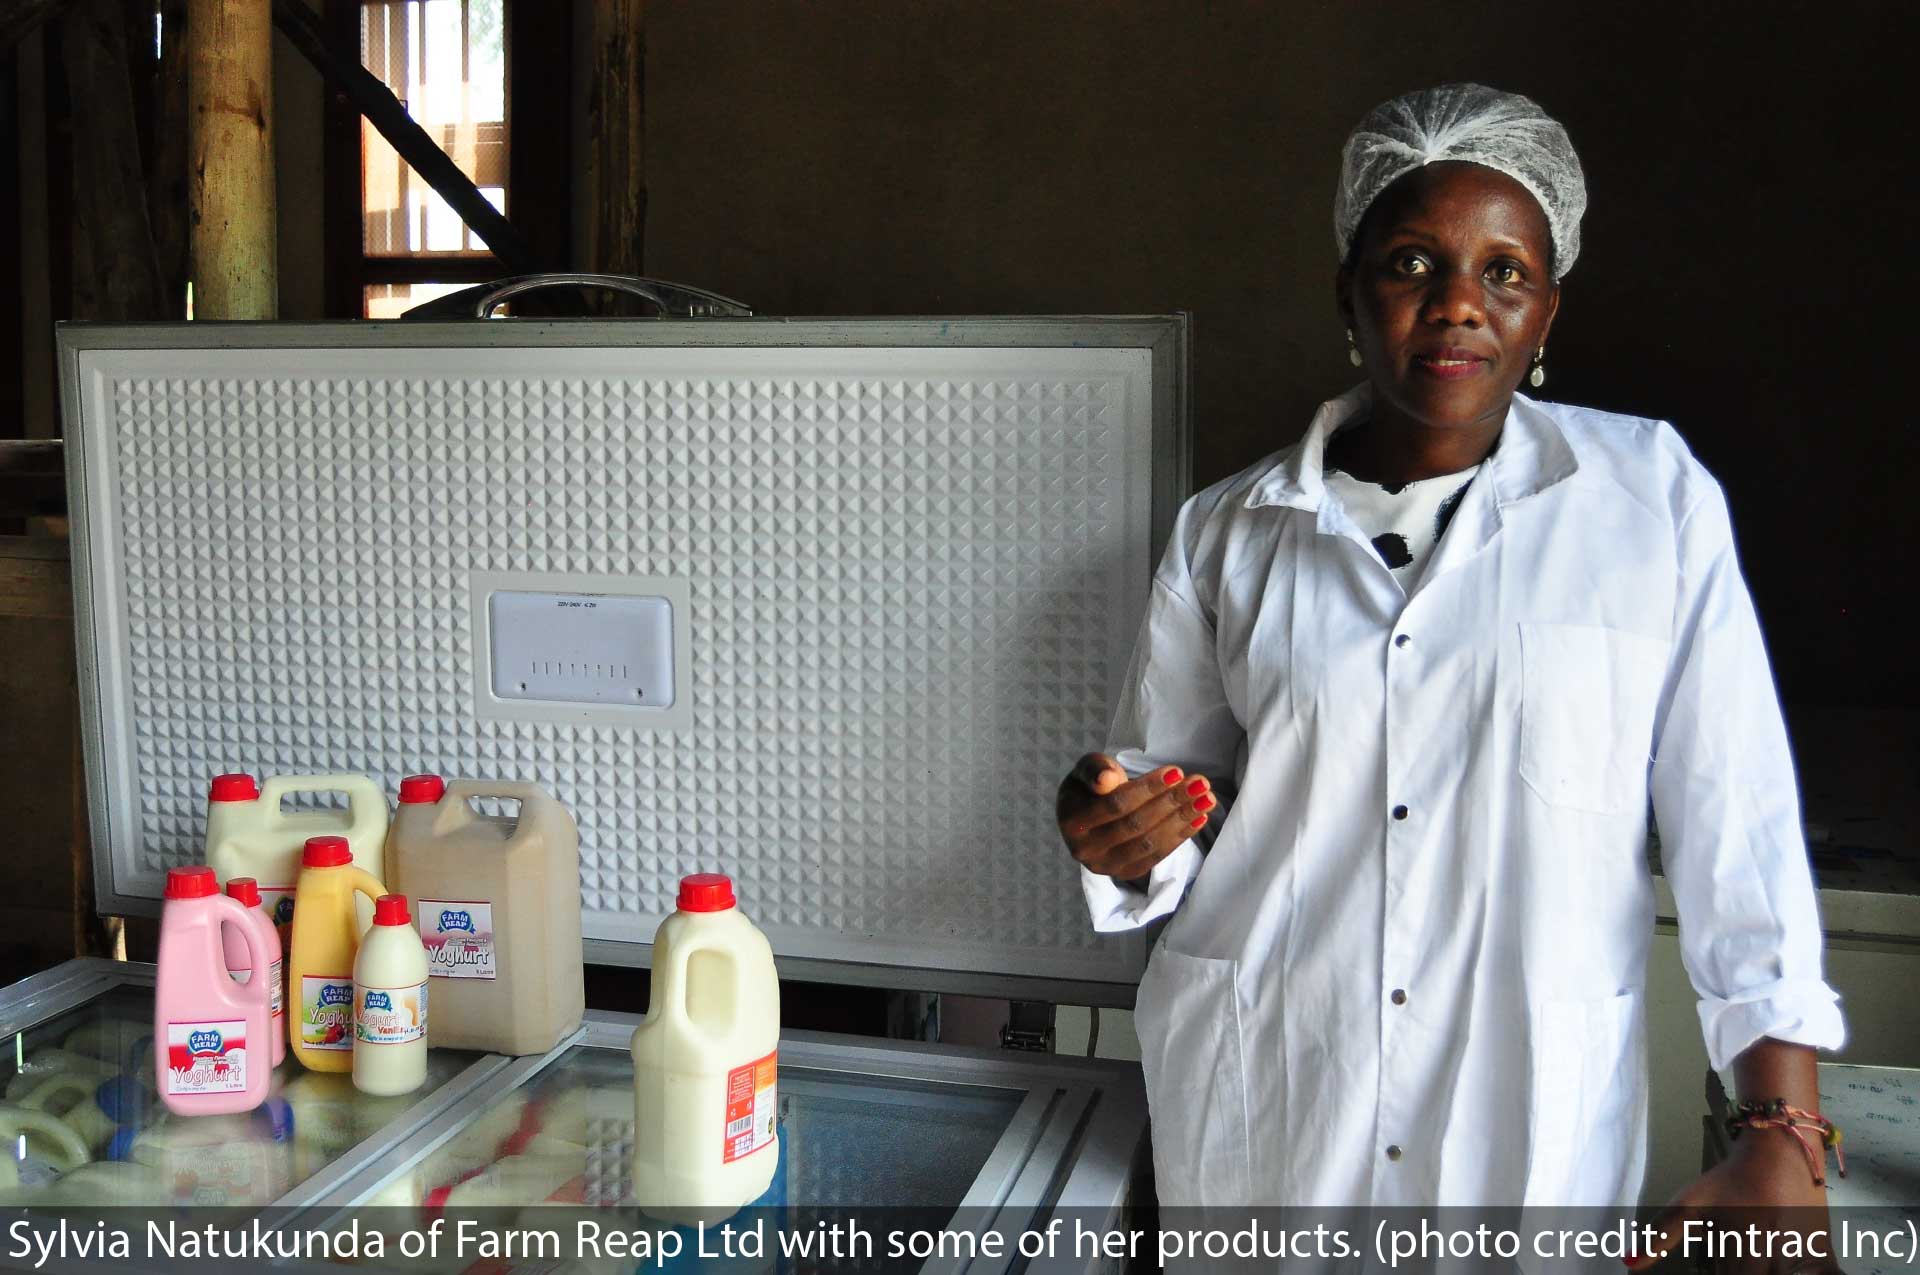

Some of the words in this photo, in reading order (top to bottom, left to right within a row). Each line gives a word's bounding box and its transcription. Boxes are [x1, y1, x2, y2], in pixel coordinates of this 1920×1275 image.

[442, 913, 468, 922] FARM
[445, 920, 467, 928] REAP
[429, 944, 489, 967] Yoghurt
[323, 988, 353, 996] FARM
[367, 994, 387, 1002] FARM
[310, 1007, 353, 1028] Yoghu
[191, 1033, 219, 1044] FARM
[194, 1041, 217, 1049] REAP
[174, 1065, 241, 1087] Yoghurt
